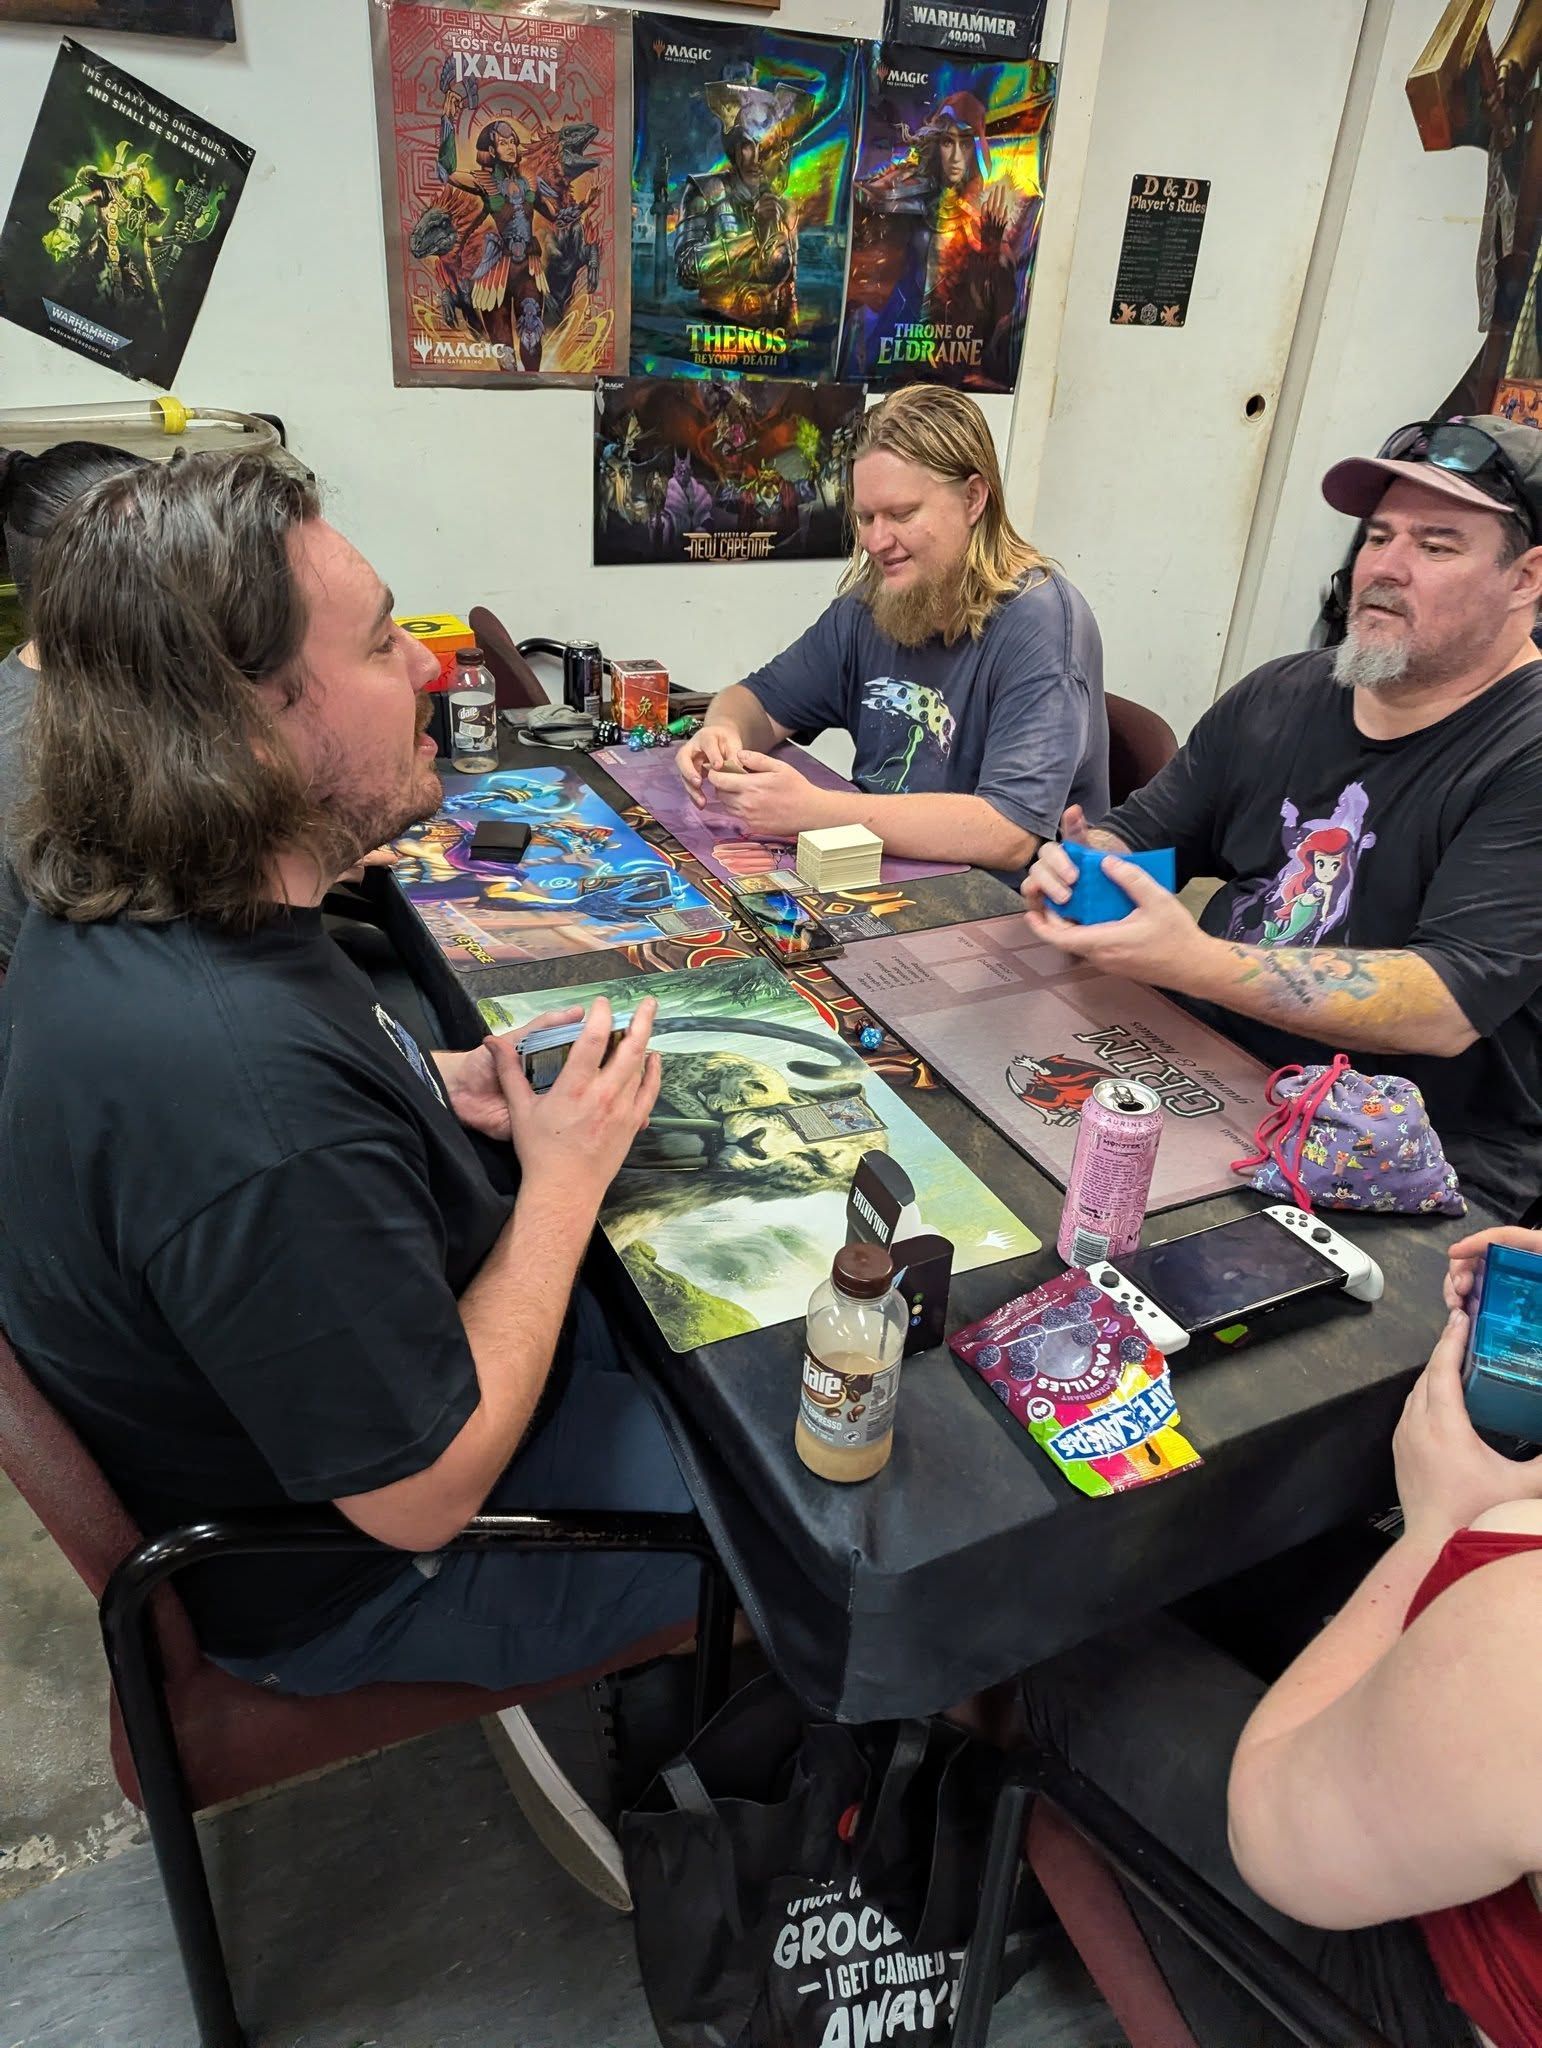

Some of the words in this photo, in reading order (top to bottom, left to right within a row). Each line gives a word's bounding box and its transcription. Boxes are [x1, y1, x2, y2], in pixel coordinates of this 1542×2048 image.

[913, 6, 1016, 37] WARHAMMER
[452, 36, 489, 51] LOST
[493, 41, 558, 59] CAVERNS
[948, 30, 980, 44] 40,000
[665, 44, 712, 61] MAGIC
[453, 51, 558, 92] IXALAN
[887, 70, 929, 85] MAGIC
[82, 64, 102, 82] THE
[105, 79, 146, 107] GALAXY
[148, 104, 169, 123] WAS
[172, 119, 199, 140] ONCE
[200, 136, 229, 160] OURS,
[87, 85, 109, 103] AND
[112, 100, 145, 125] SHALL
[148, 121, 163, 135] BE
[165, 131, 179, 143] SO
[181, 141, 216, 166] AGAIN!
[1142, 176, 1160, 196] D
[1182, 179, 1200, 199] D
[1131, 195, 1175, 212] Player's
[1176, 199, 1207, 214] Rules
[52, 307, 120, 347] WARHAMMER
[685, 324, 787, 354] THEROS
[894, 323, 953, 339] THRONE
[955, 324, 974, 339] OF
[433, 341, 507, 359] MAGIC
[694, 353, 738, 365] BEYOND
[743, 354, 778, 366] DEATH
[877, 336, 984, 369] ELDRAINE
[690, 538, 717, 559] NEW
[720, 537, 769, 559] CAPENNA
[1130, 1021, 1180, 1055] hobbies
[1072, 1024, 1226, 1119] GRIM
[1175, 1057, 1197, 1067] &
[1196, 1068, 1255, 1105] gaming
[1102, 1116, 1144, 1128] AURINE
[1220, 1129, 1260, 1157] ttlefield
[802, 1353, 842, 1398] dare
[1037, 1343, 1112, 1394] PASTILLES
[1061, 1369, 1117, 1401] ACKCURRANT
[773, 1906, 903, 1969] GROCE
[825, 1967, 835, 2000] I
[837, 1960, 870, 1998] GET
[874, 1951, 946, 1985] CARRIED
